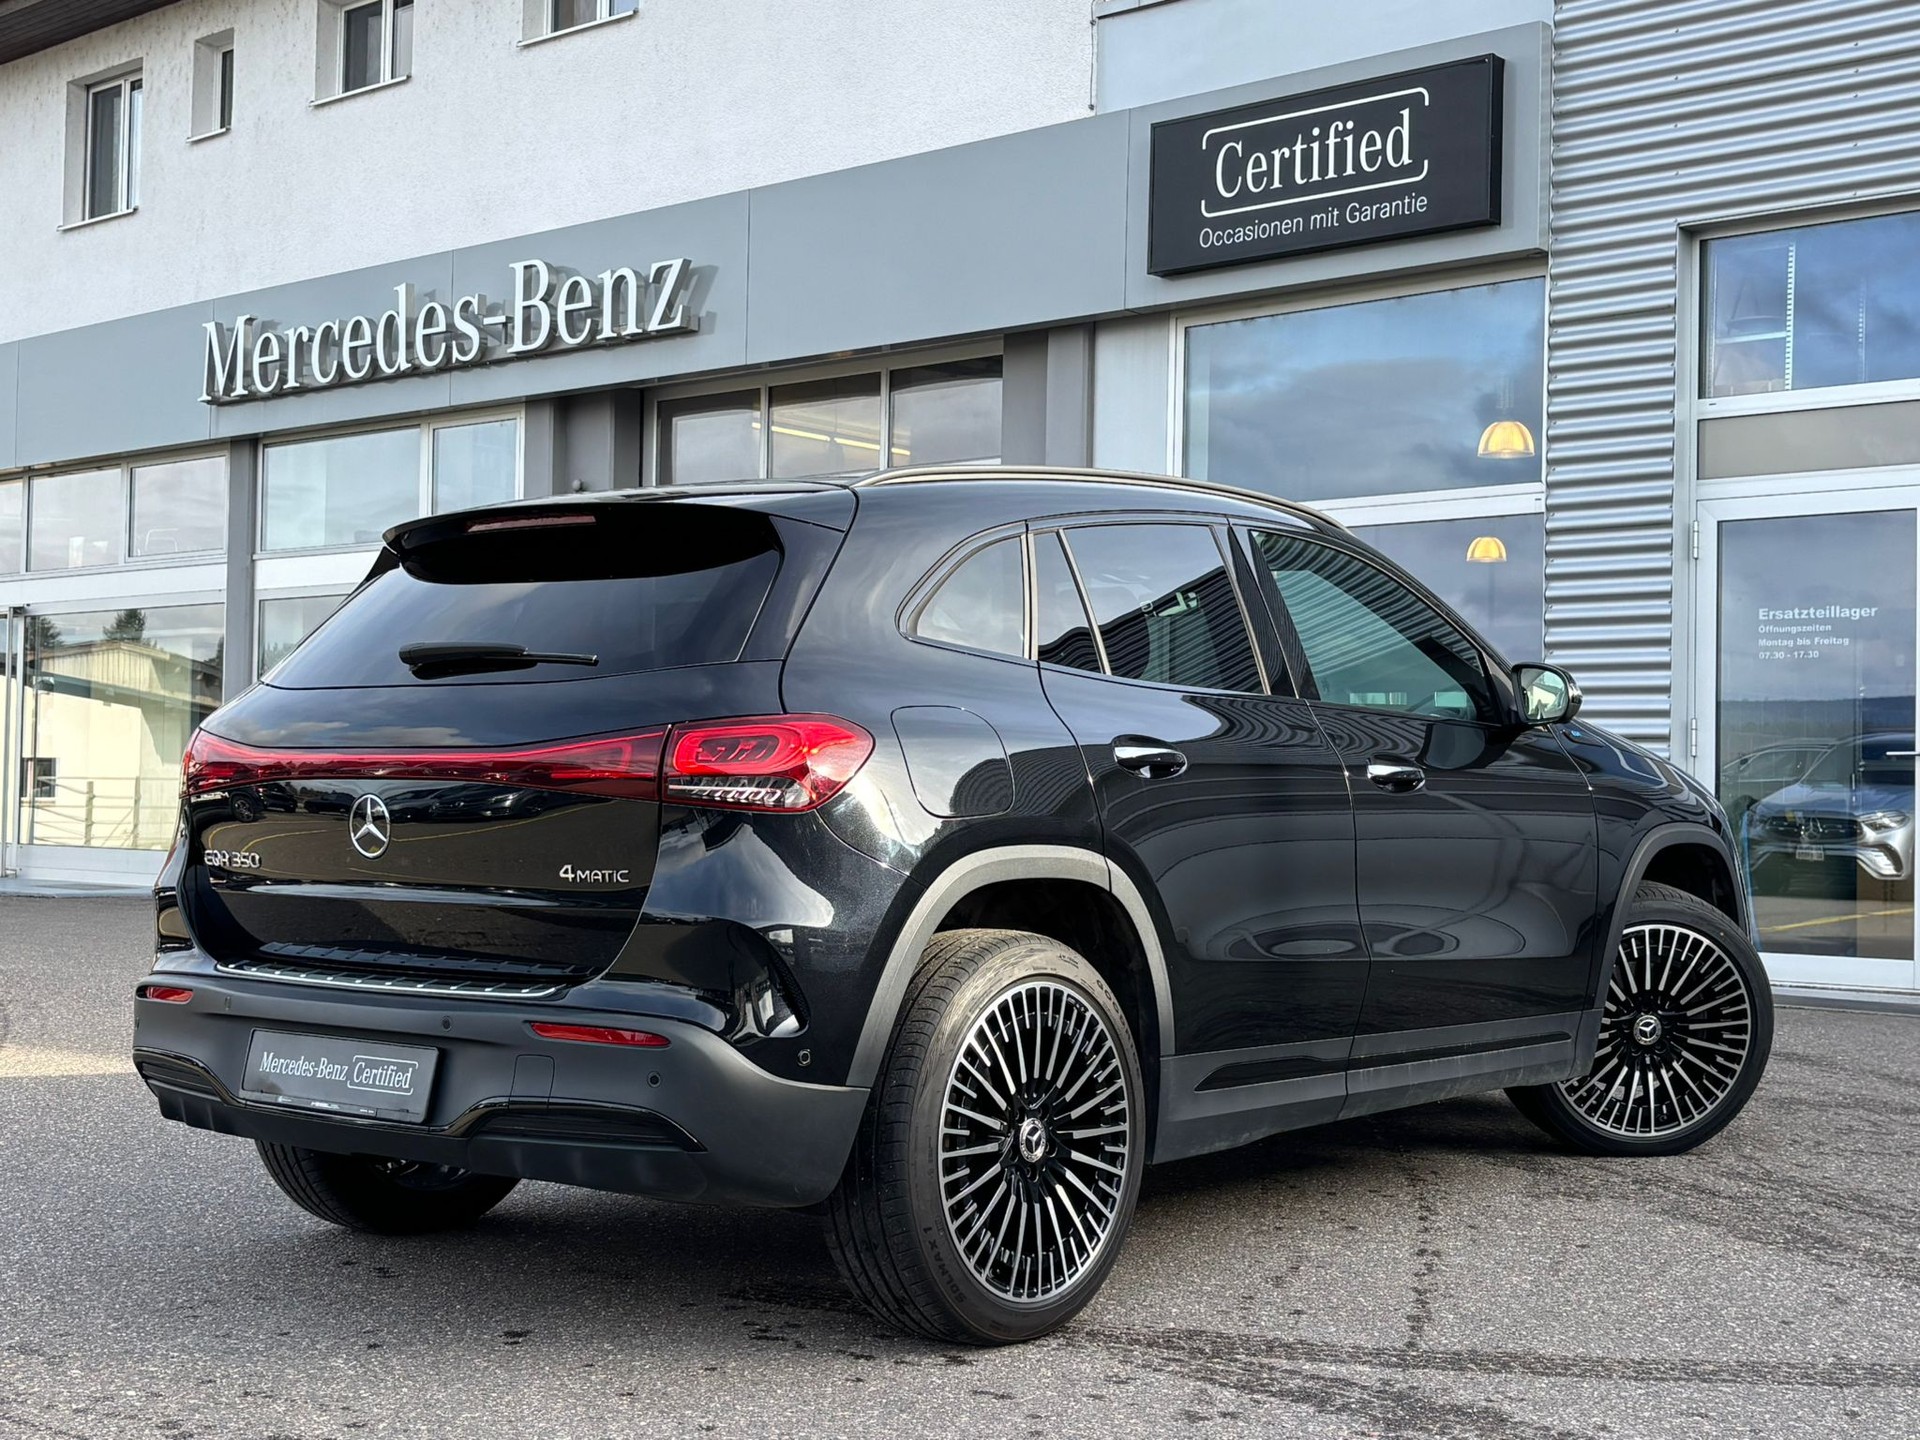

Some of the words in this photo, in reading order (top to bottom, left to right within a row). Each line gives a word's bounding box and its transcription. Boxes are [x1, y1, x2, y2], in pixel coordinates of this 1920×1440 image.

[1215, 107, 1413, 198] Certified
[1199, 215, 1303, 248] Occasionen
[1310, 206, 1340, 230] mit
[1346, 192, 1429, 224] Garantie
[198, 257, 695, 403] Mercedes-Benz
[1758, 605, 1878, 620] Ersatzteillager
[1758, 638, 1794, 647] Montag
[1796, 637, 1811, 645] bis
[1814, 636, 1850, 645] Freitag
[1758, 651, 1785, 659] 07.30
[1794, 650, 1820, 658] 17.30
[204, 849, 230, 867] EQA
[231, 851, 261, 868] 350
[559, 864, 630, 883] 4MATIC
[259, 1051, 350, 1081] Mercedes-Benz
[353, 1061, 413, 1089] Certified
